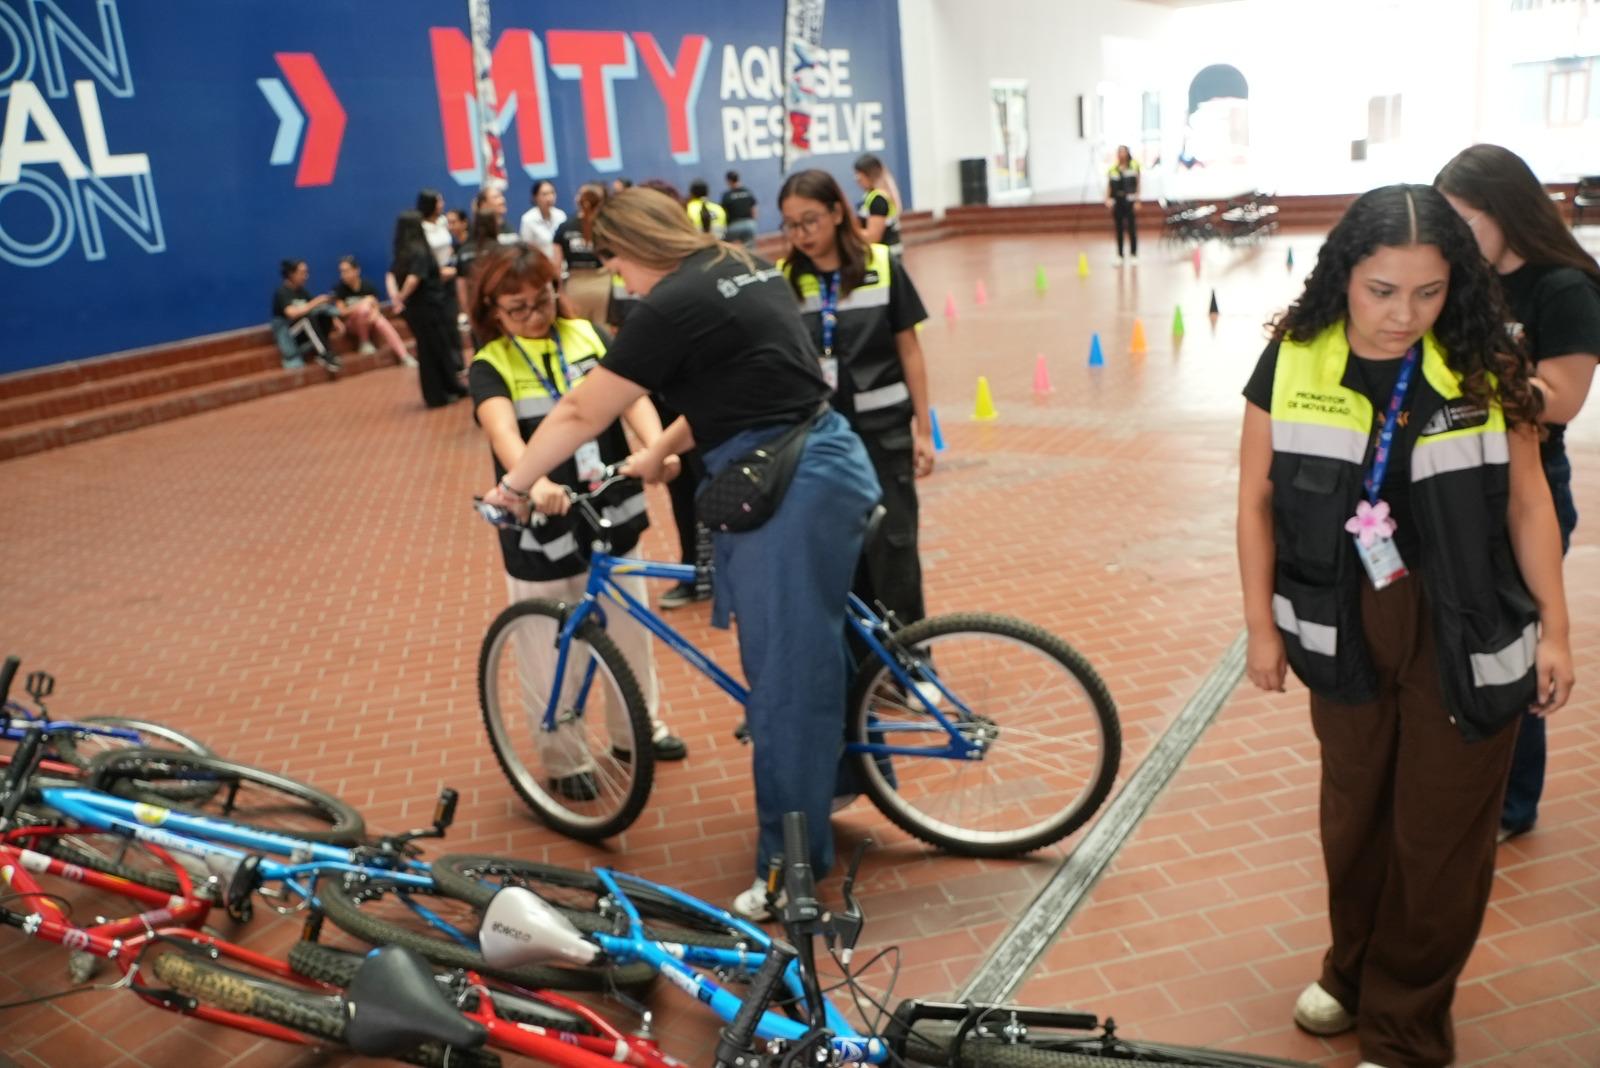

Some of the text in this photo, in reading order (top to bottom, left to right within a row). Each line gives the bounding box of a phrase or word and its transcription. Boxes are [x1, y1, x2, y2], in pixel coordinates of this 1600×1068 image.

[430, 27, 712, 187] MTY
[720, 44, 785, 101] AQU
[0, 80, 150, 184] AL
[721, 102, 885, 161] RESELVE
[0, 167, 166, 268] ON
